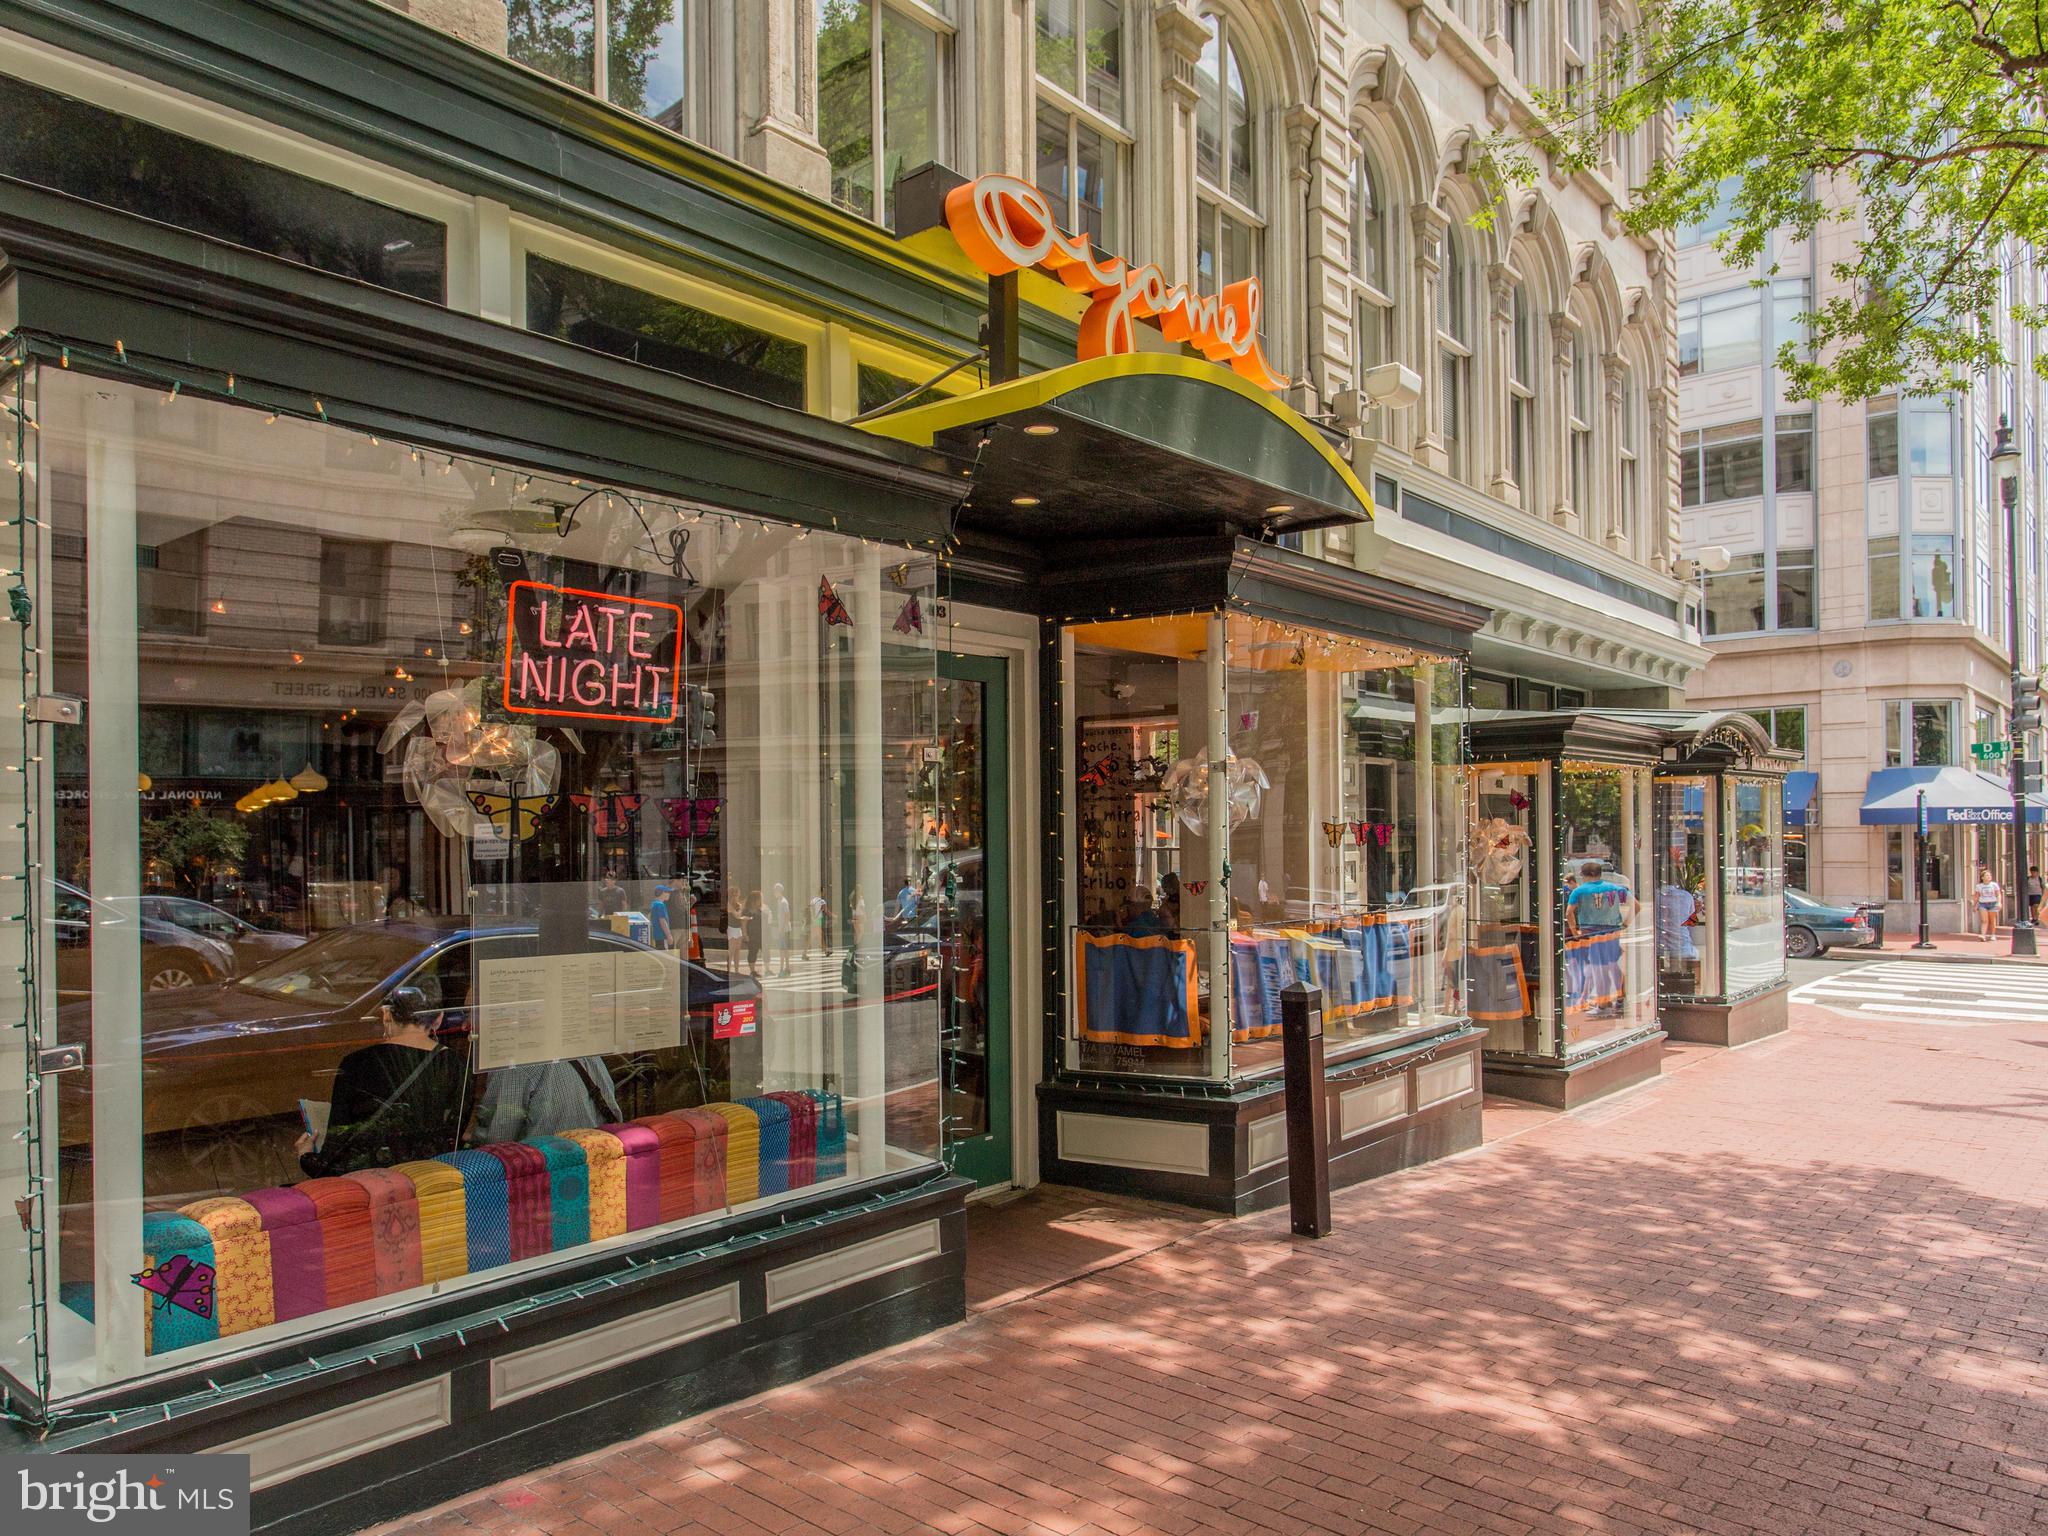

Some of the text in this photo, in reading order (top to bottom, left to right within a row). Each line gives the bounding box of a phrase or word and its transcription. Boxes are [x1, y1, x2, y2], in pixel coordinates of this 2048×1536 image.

[539, 600, 654, 659] LATE
[519, 652, 670, 709] NIGHT
[1983, 743, 1993, 752] D
[1947, 808, 2013, 821] FedEx Office
[1103, 1044, 1146, 1057] OYAMEL
